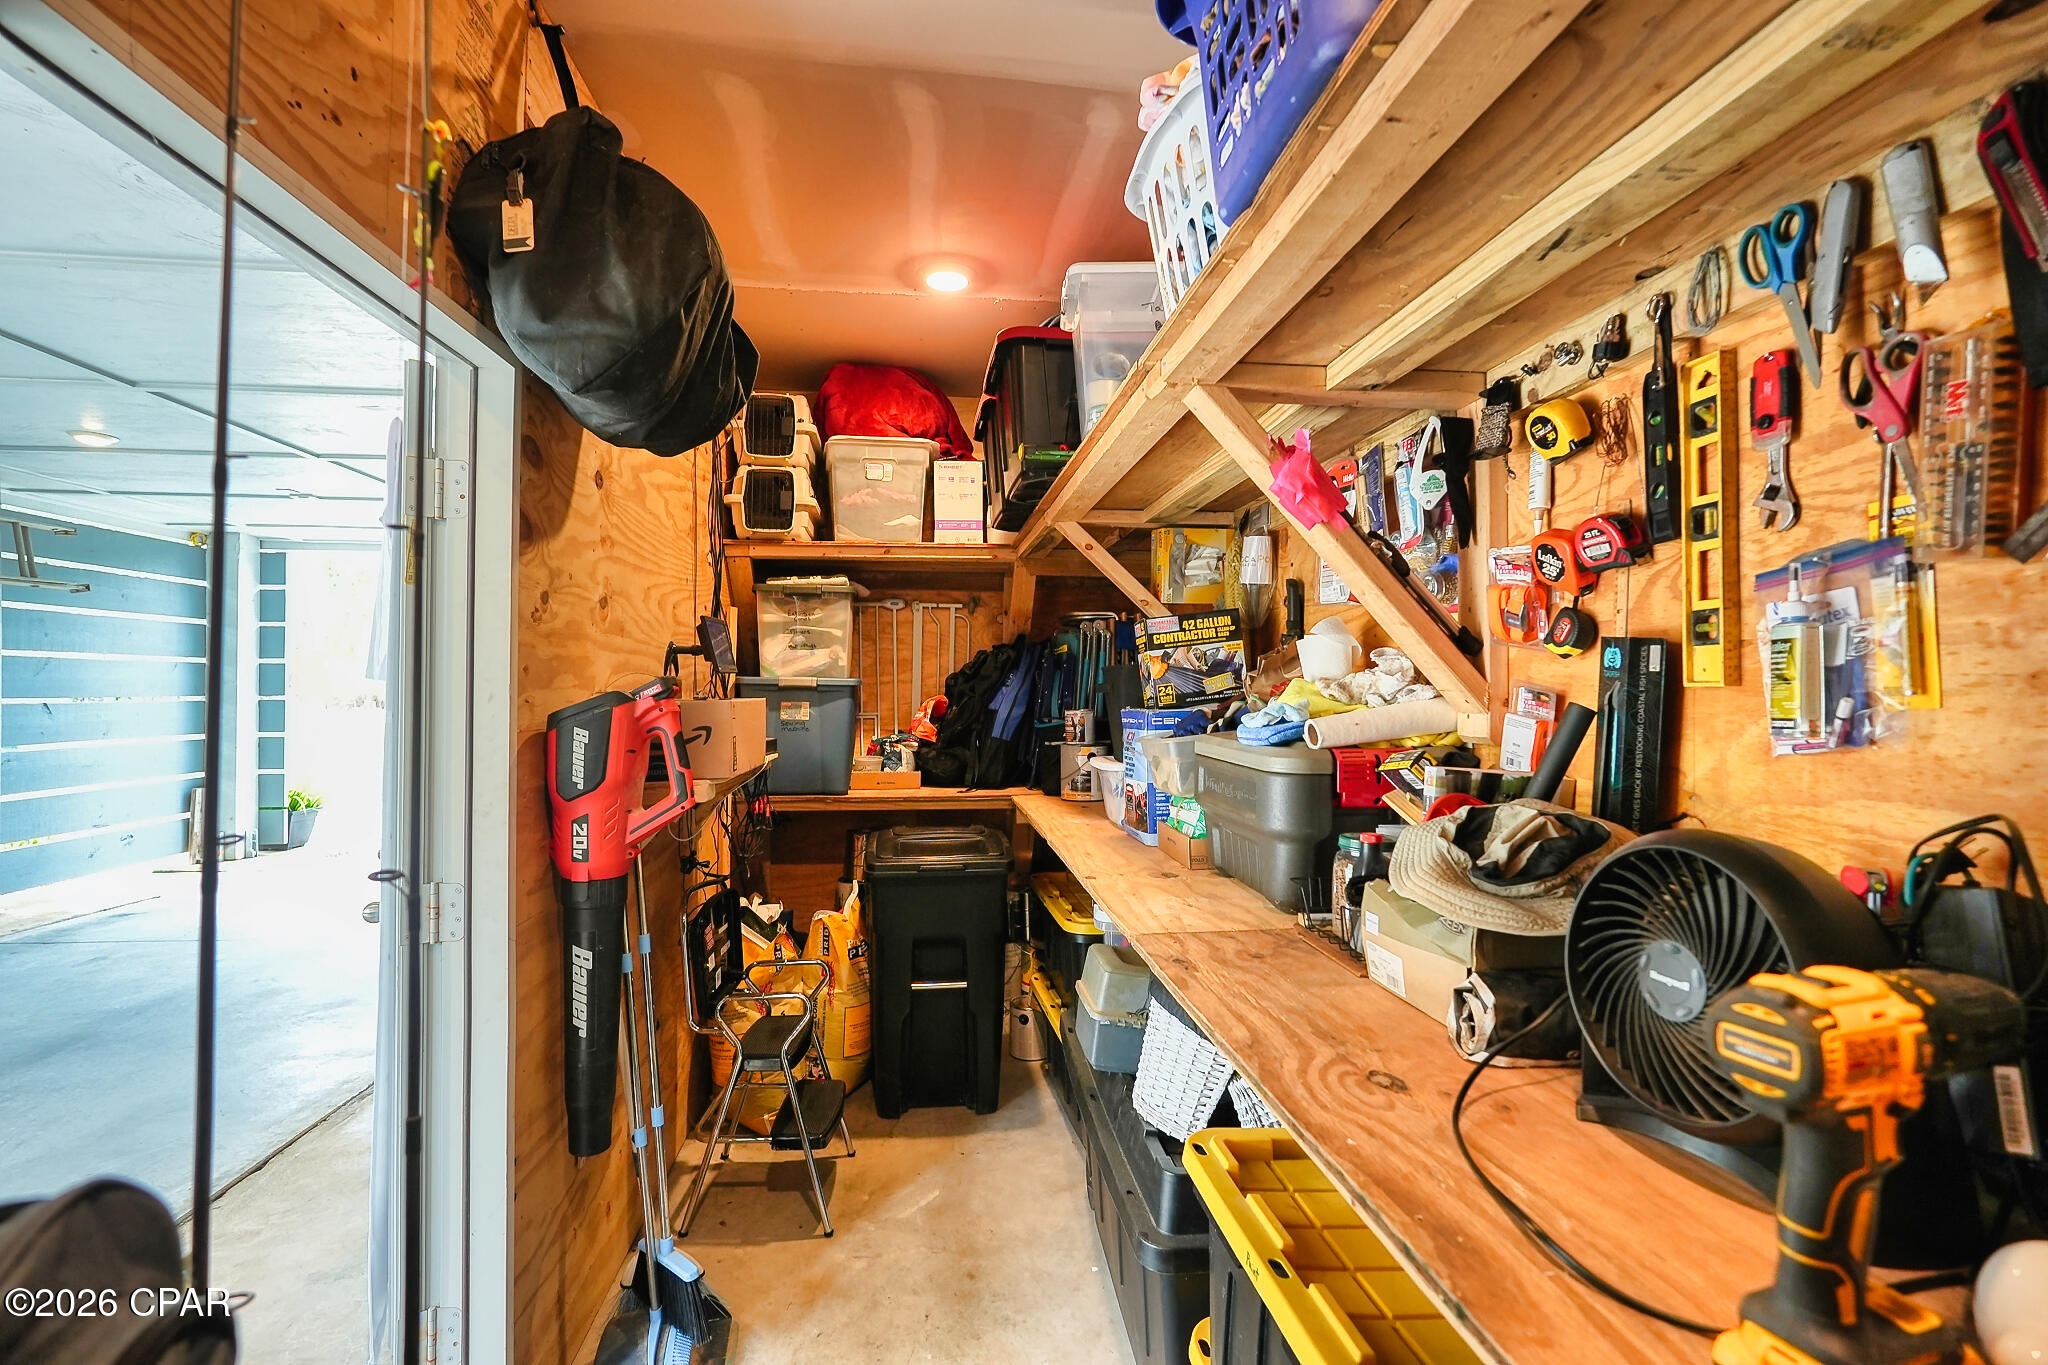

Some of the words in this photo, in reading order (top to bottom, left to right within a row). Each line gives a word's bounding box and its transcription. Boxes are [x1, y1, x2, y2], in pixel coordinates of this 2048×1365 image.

[1537, 549, 1562, 568] Lufkin
[1182, 620, 1195, 630] 42
[1196, 615, 1232, 628] GALLON
[1152, 628, 1216, 644] CONTRACTOR
[1640, 645, 1648, 674] SPECIES
[1158, 686, 1173, 696] 24
[1639, 675, 1647, 690] FISH
[1638, 692, 1646, 723] COASTAL
[1635, 724, 1645, 768] RESTOCKING
[571, 726, 590, 790] Bauer
[1635, 768, 1642, 778] BY
[1634, 778, 1642, 798] BACK
[572, 944, 593, 1038] Bauer
